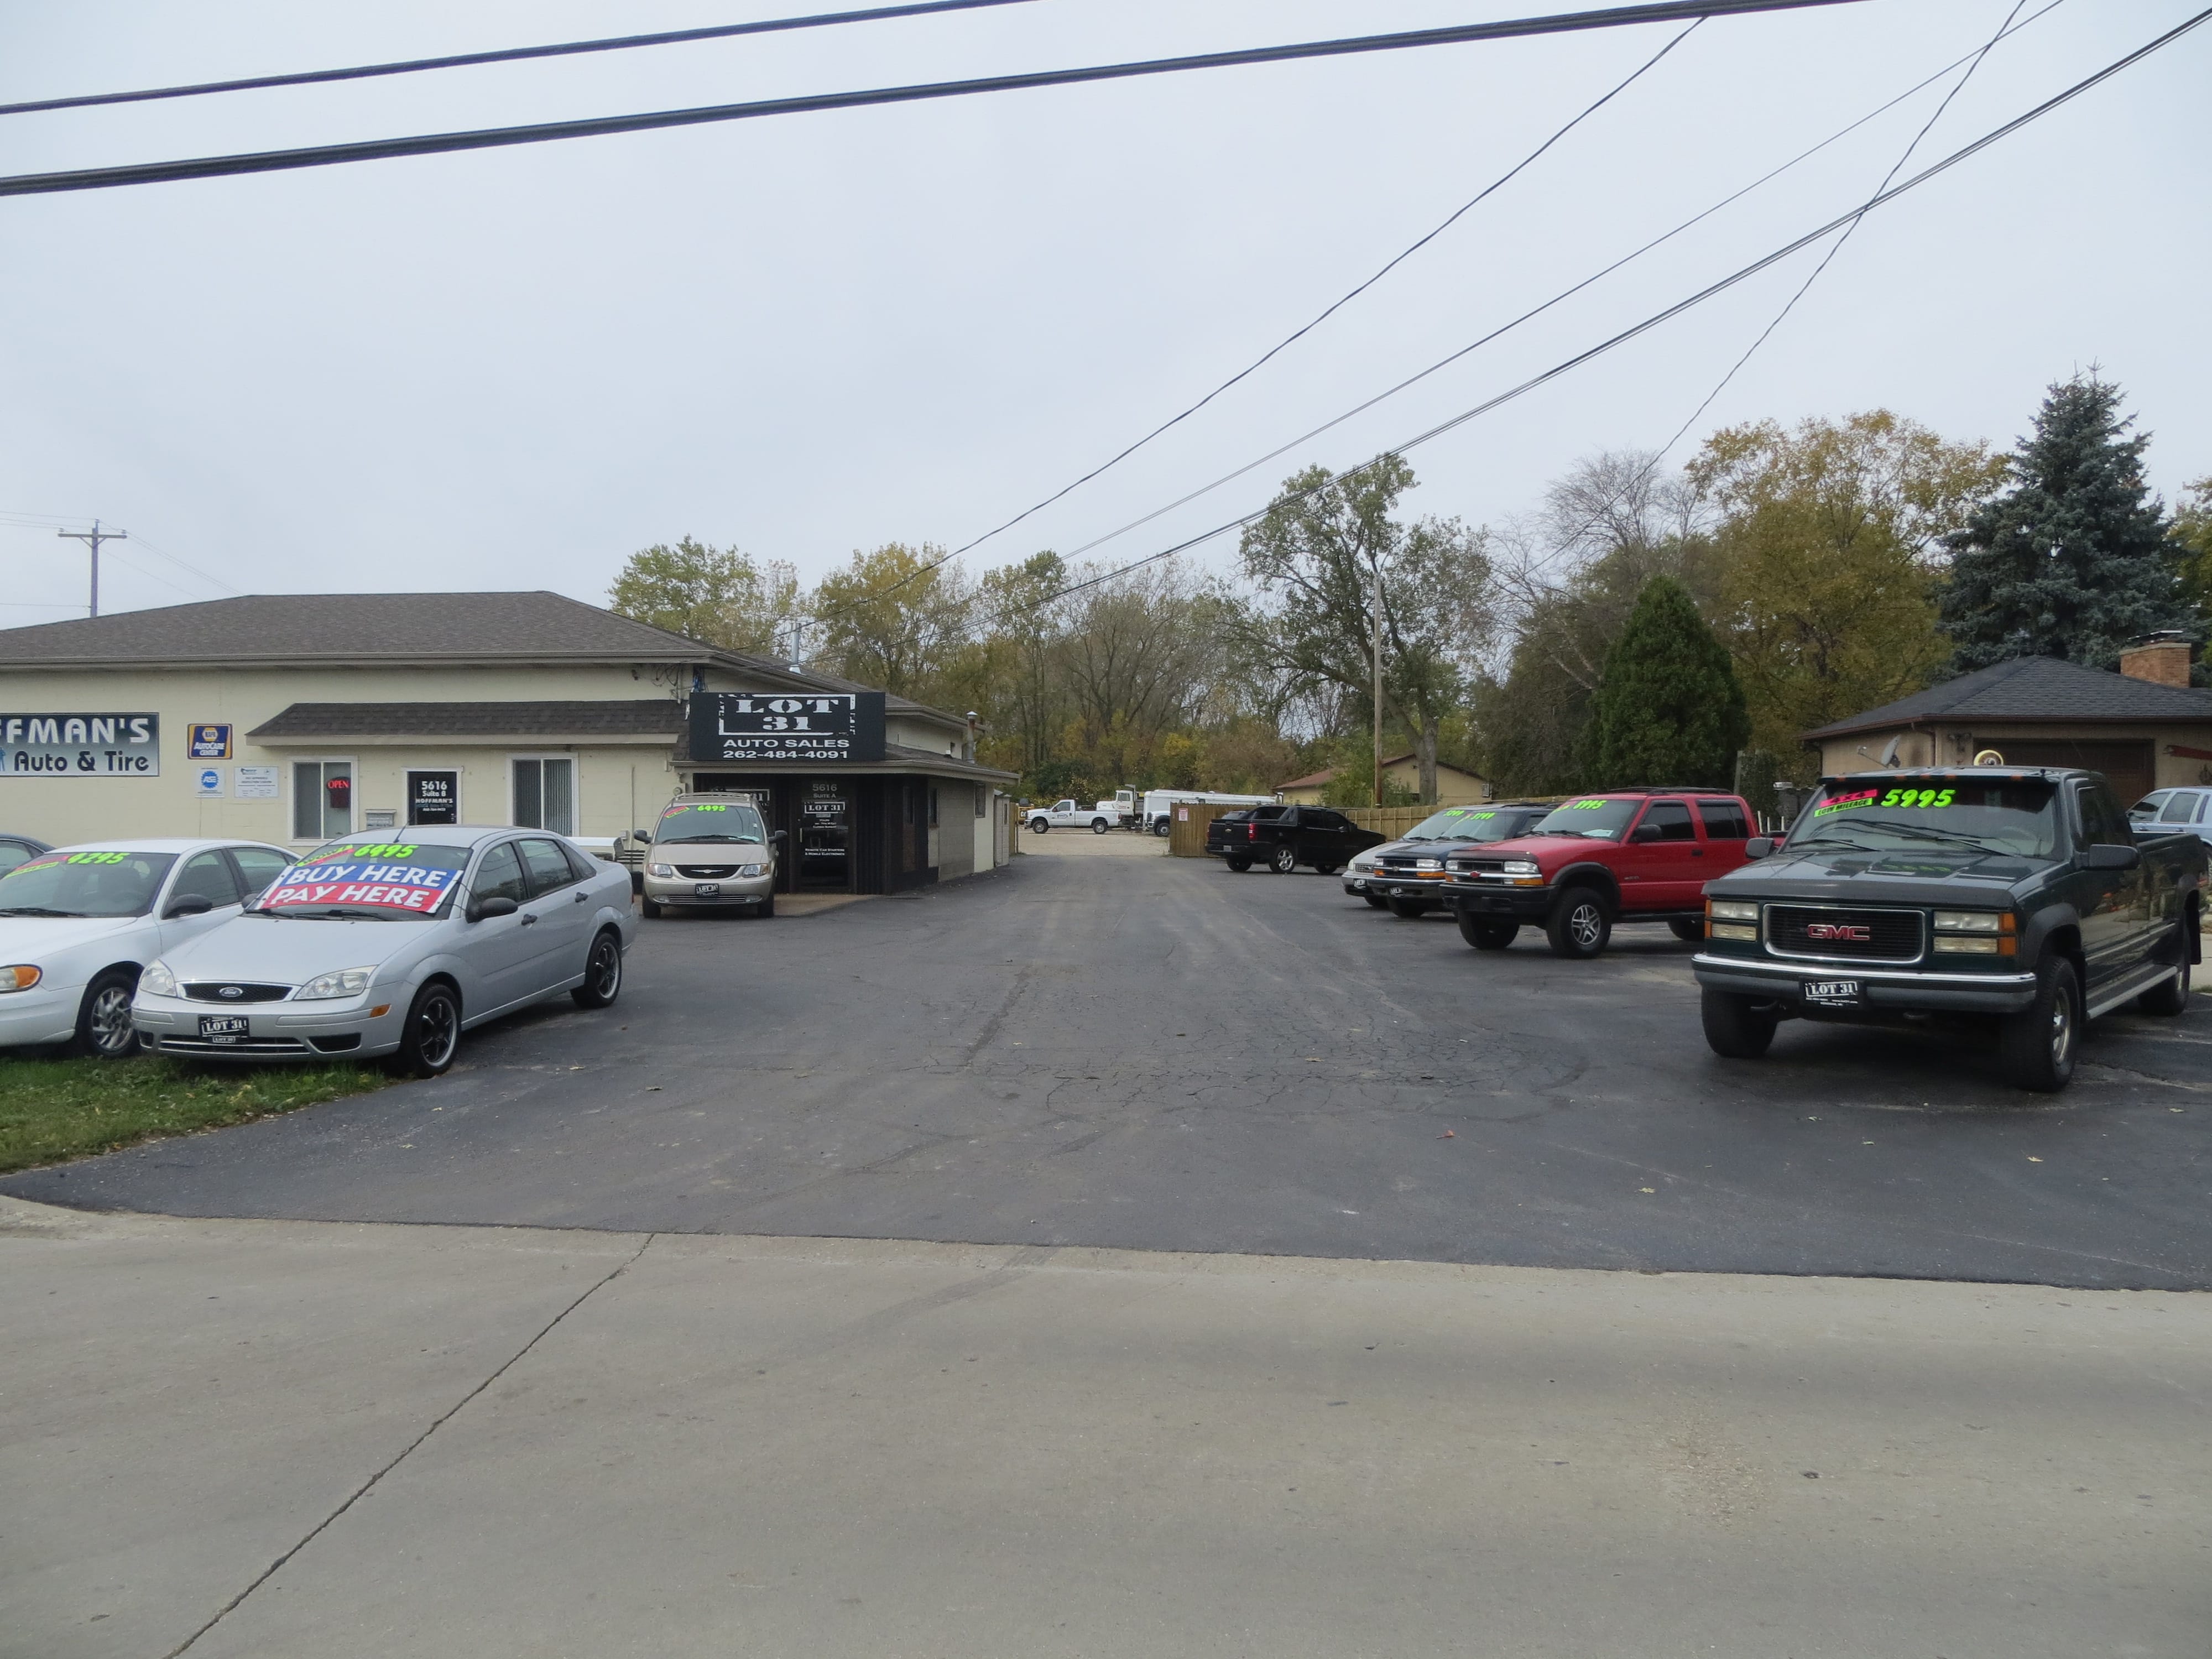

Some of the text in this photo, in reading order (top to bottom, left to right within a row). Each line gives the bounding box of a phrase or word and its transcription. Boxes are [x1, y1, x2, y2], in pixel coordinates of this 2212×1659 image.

[736, 700, 839, 713] LOT
[763, 717, 811, 730] 31
[14, 750, 149, 771] Auto & Tire
[723, 750, 848, 759] 262-484-4091
[328, 780, 348, 789] OPEN
[421, 781, 447, 790] 5616
[1835, 799, 1869, 811] MILEAGE
[1881, 789, 1956, 808] 5995
[354, 844, 419, 858] 6495
[286, 865, 447, 887] BUY HERE
[269, 885, 430, 907] PAY HERE
[1808, 924, 1870, 940] GMC
[1811, 983, 1854, 994] LOT 31
[206, 1019, 243, 1031] LOT 31
